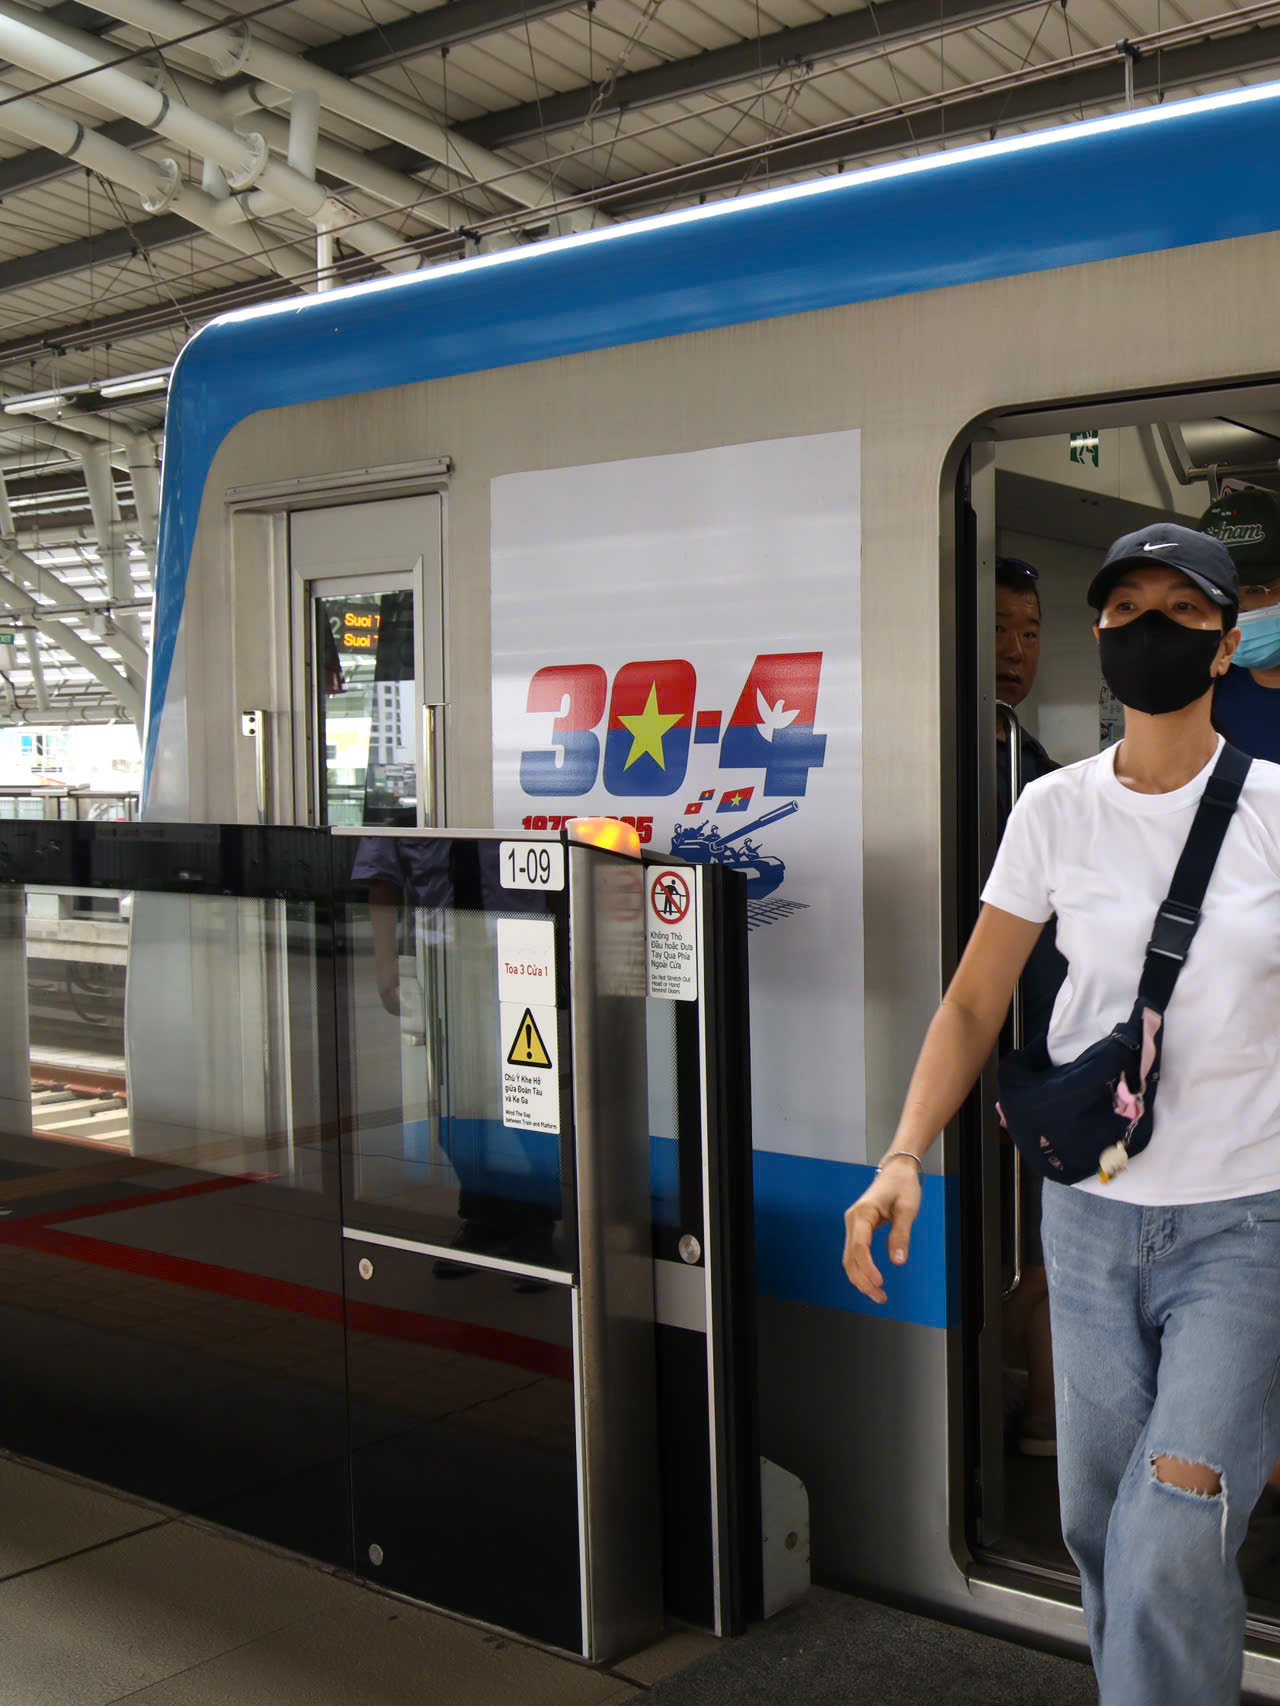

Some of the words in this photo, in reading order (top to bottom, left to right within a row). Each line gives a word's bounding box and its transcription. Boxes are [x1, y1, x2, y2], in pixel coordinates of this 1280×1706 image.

[520, 652, 827, 797] 30-4
[508, 848, 550, 884] 1-09
[504, 963, 518, 974] Toa
[520, 964, 525, 975] 3
[527, 964, 542, 976] Cửa
[545, 966, 548, 976] 1
